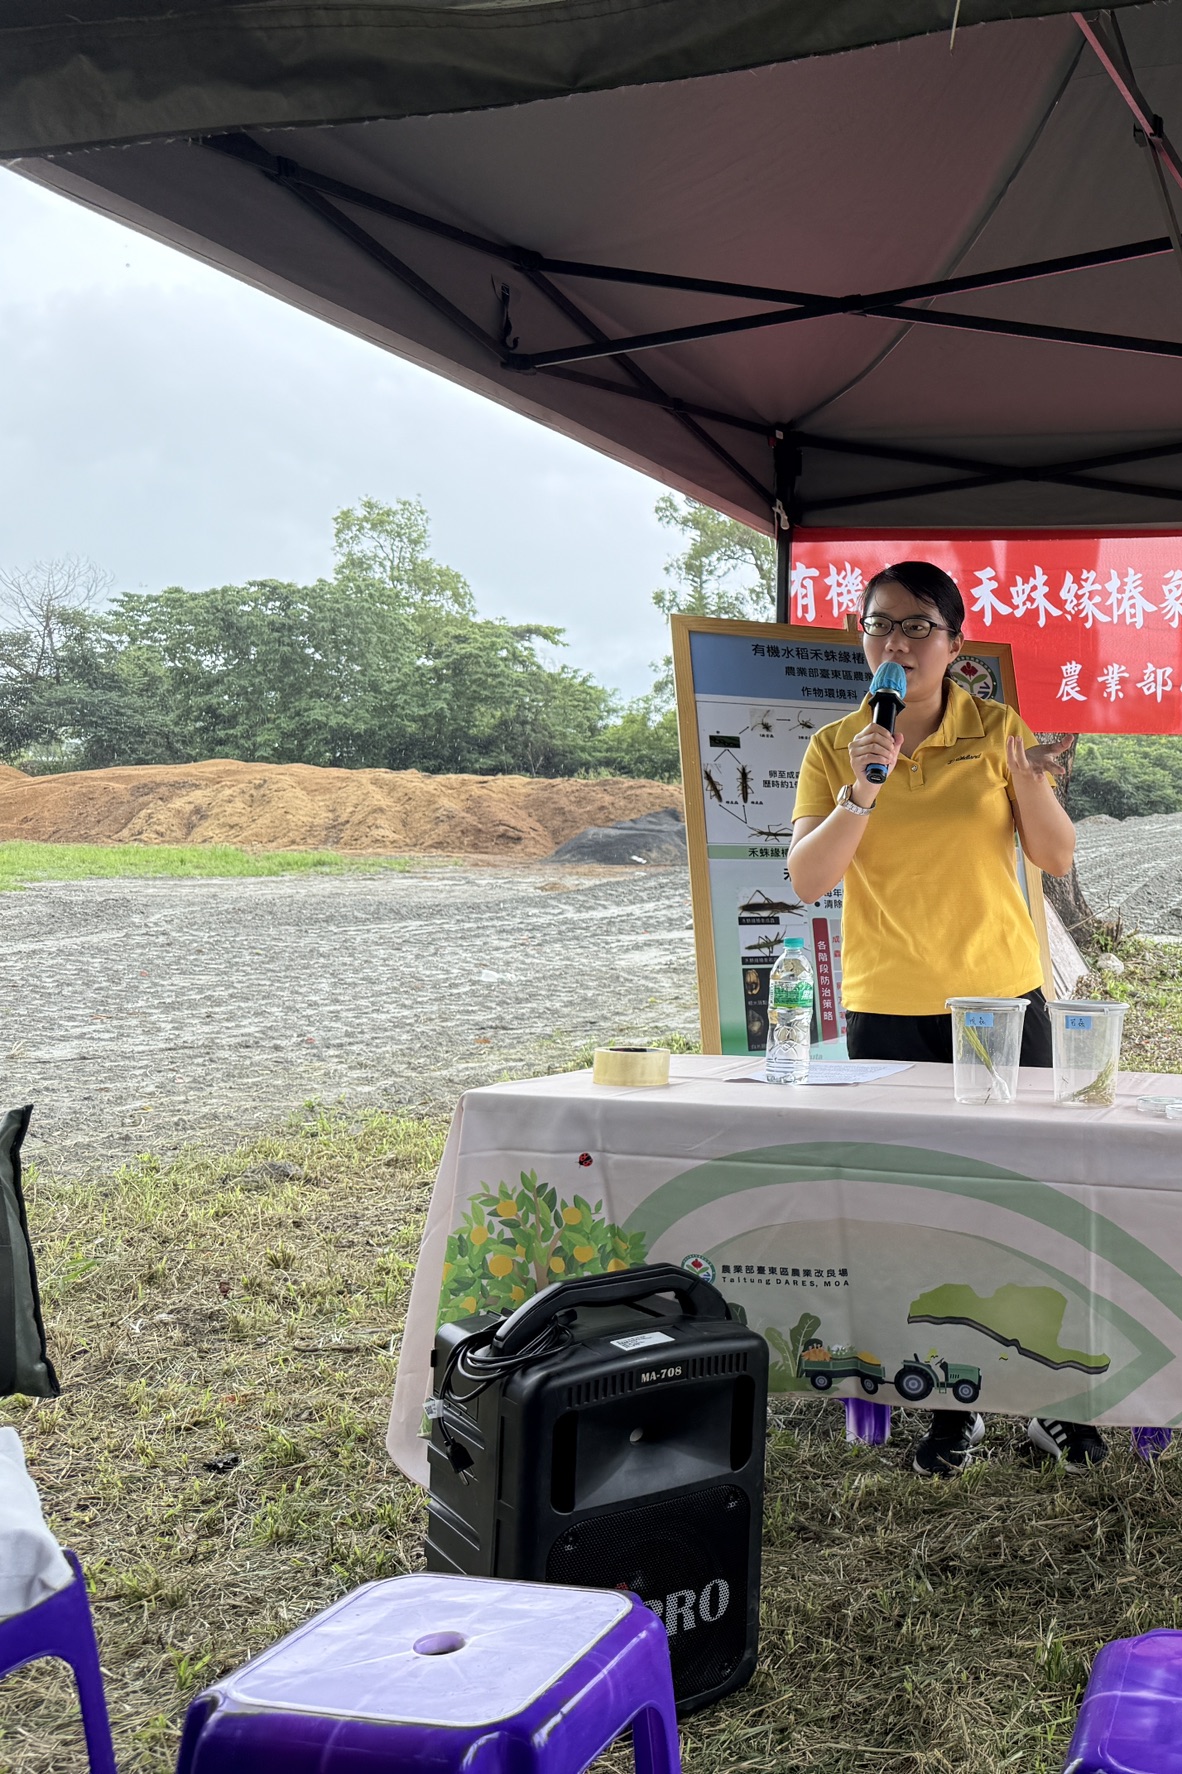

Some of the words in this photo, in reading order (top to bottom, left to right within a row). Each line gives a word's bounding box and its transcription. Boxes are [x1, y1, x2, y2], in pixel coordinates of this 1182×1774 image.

[801, 686, 858, 700] 作物環境科
[817, 941, 833, 1021] 各階段防治策略
[721, 1265, 849, 1278] 農業部臺東區農業改良場
[721, 1276, 771, 1286] Taitung
[775, 1278, 819, 1288] DARES,
[641, 1366, 683, 1384] MA-708
